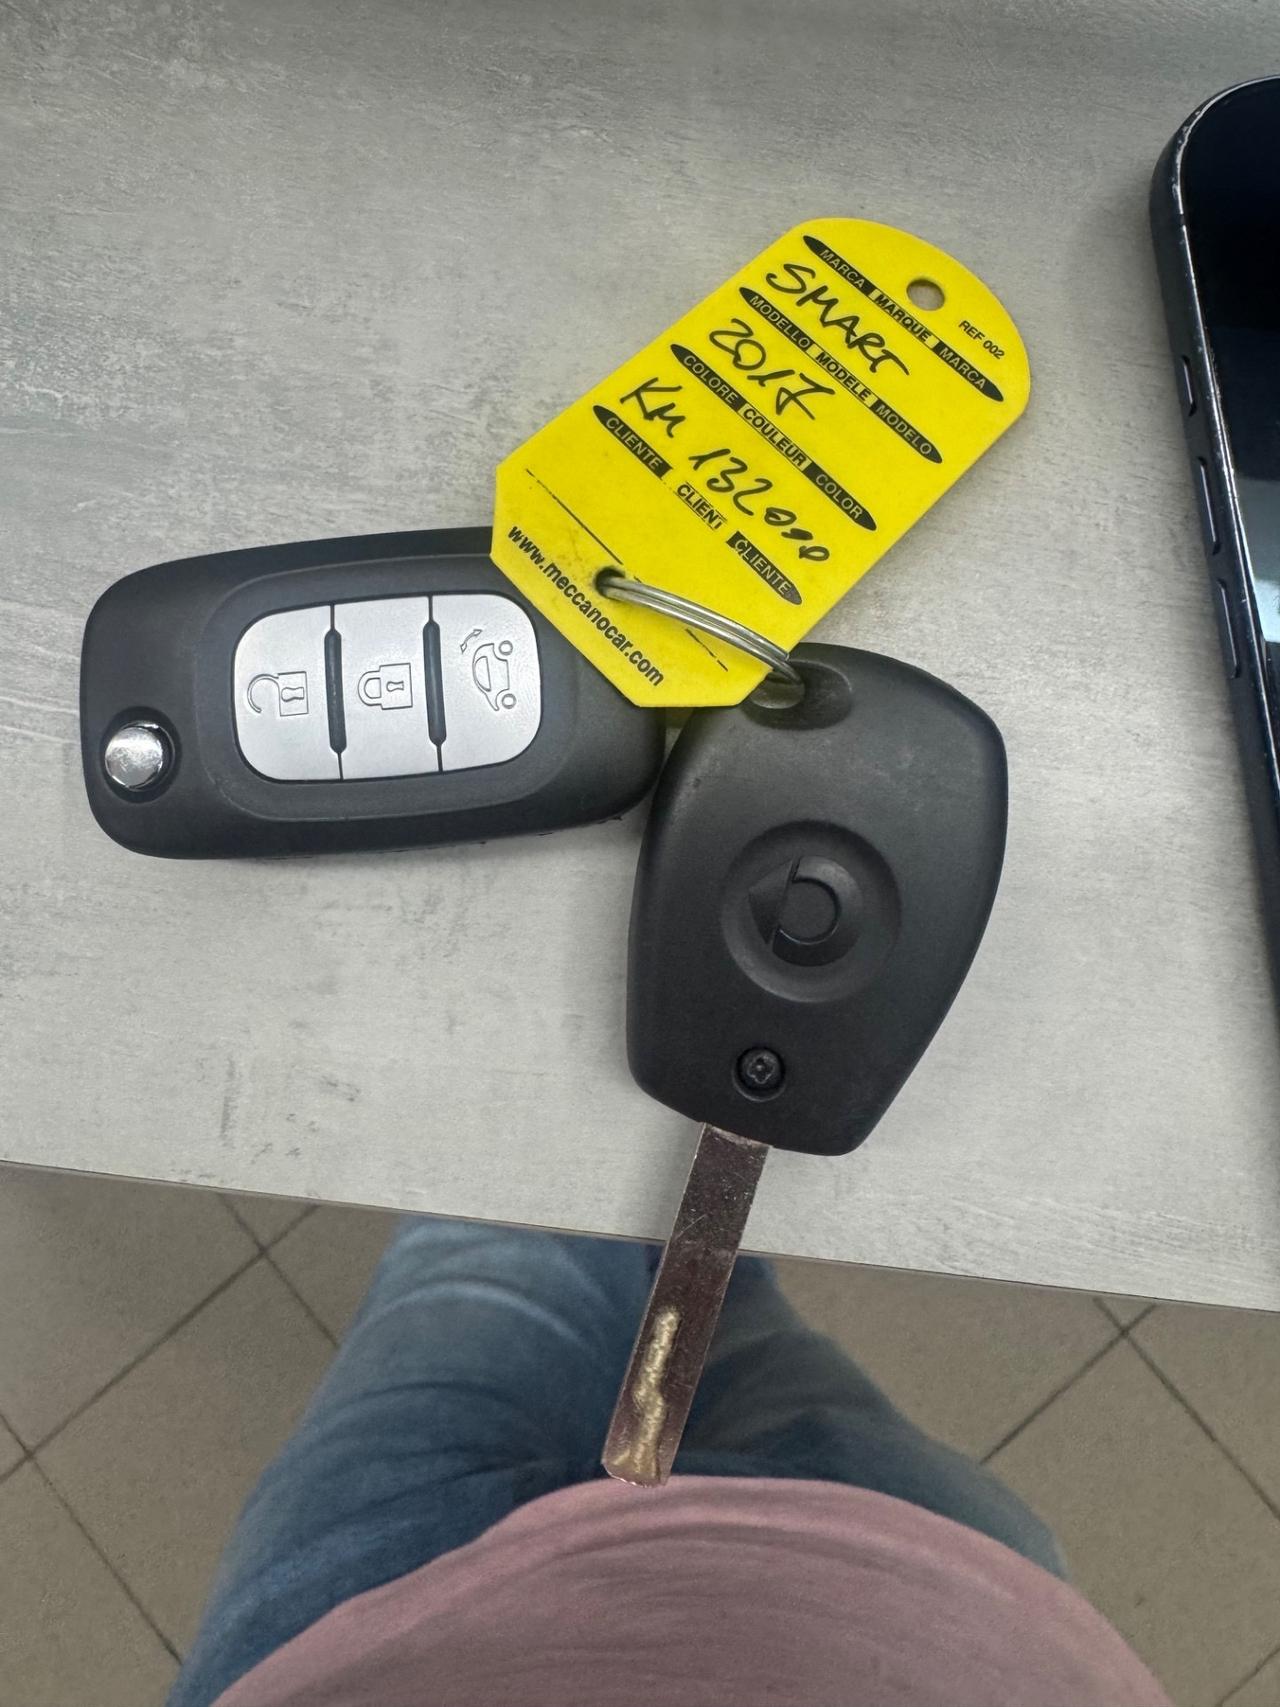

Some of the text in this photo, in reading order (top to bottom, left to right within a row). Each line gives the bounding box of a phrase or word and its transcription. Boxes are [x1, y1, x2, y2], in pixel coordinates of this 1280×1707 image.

[709, 320, 836, 421] 2017
[750, 295, 932, 455] MODELLO MODELE MODELO
[765, 263, 910, 376] SMART
[820, 249, 986, 390] MARCA MARQUE MARCA
[958, 320, 1005, 360] REF 002
[605, 417, 663, 470] CLIENTE
[734, 538, 792, 596] CLIENTE
[683, 354, 863, 520] COLORE COULEUR COLOR
[507, 526, 664, 687] www.meccanocar.com
